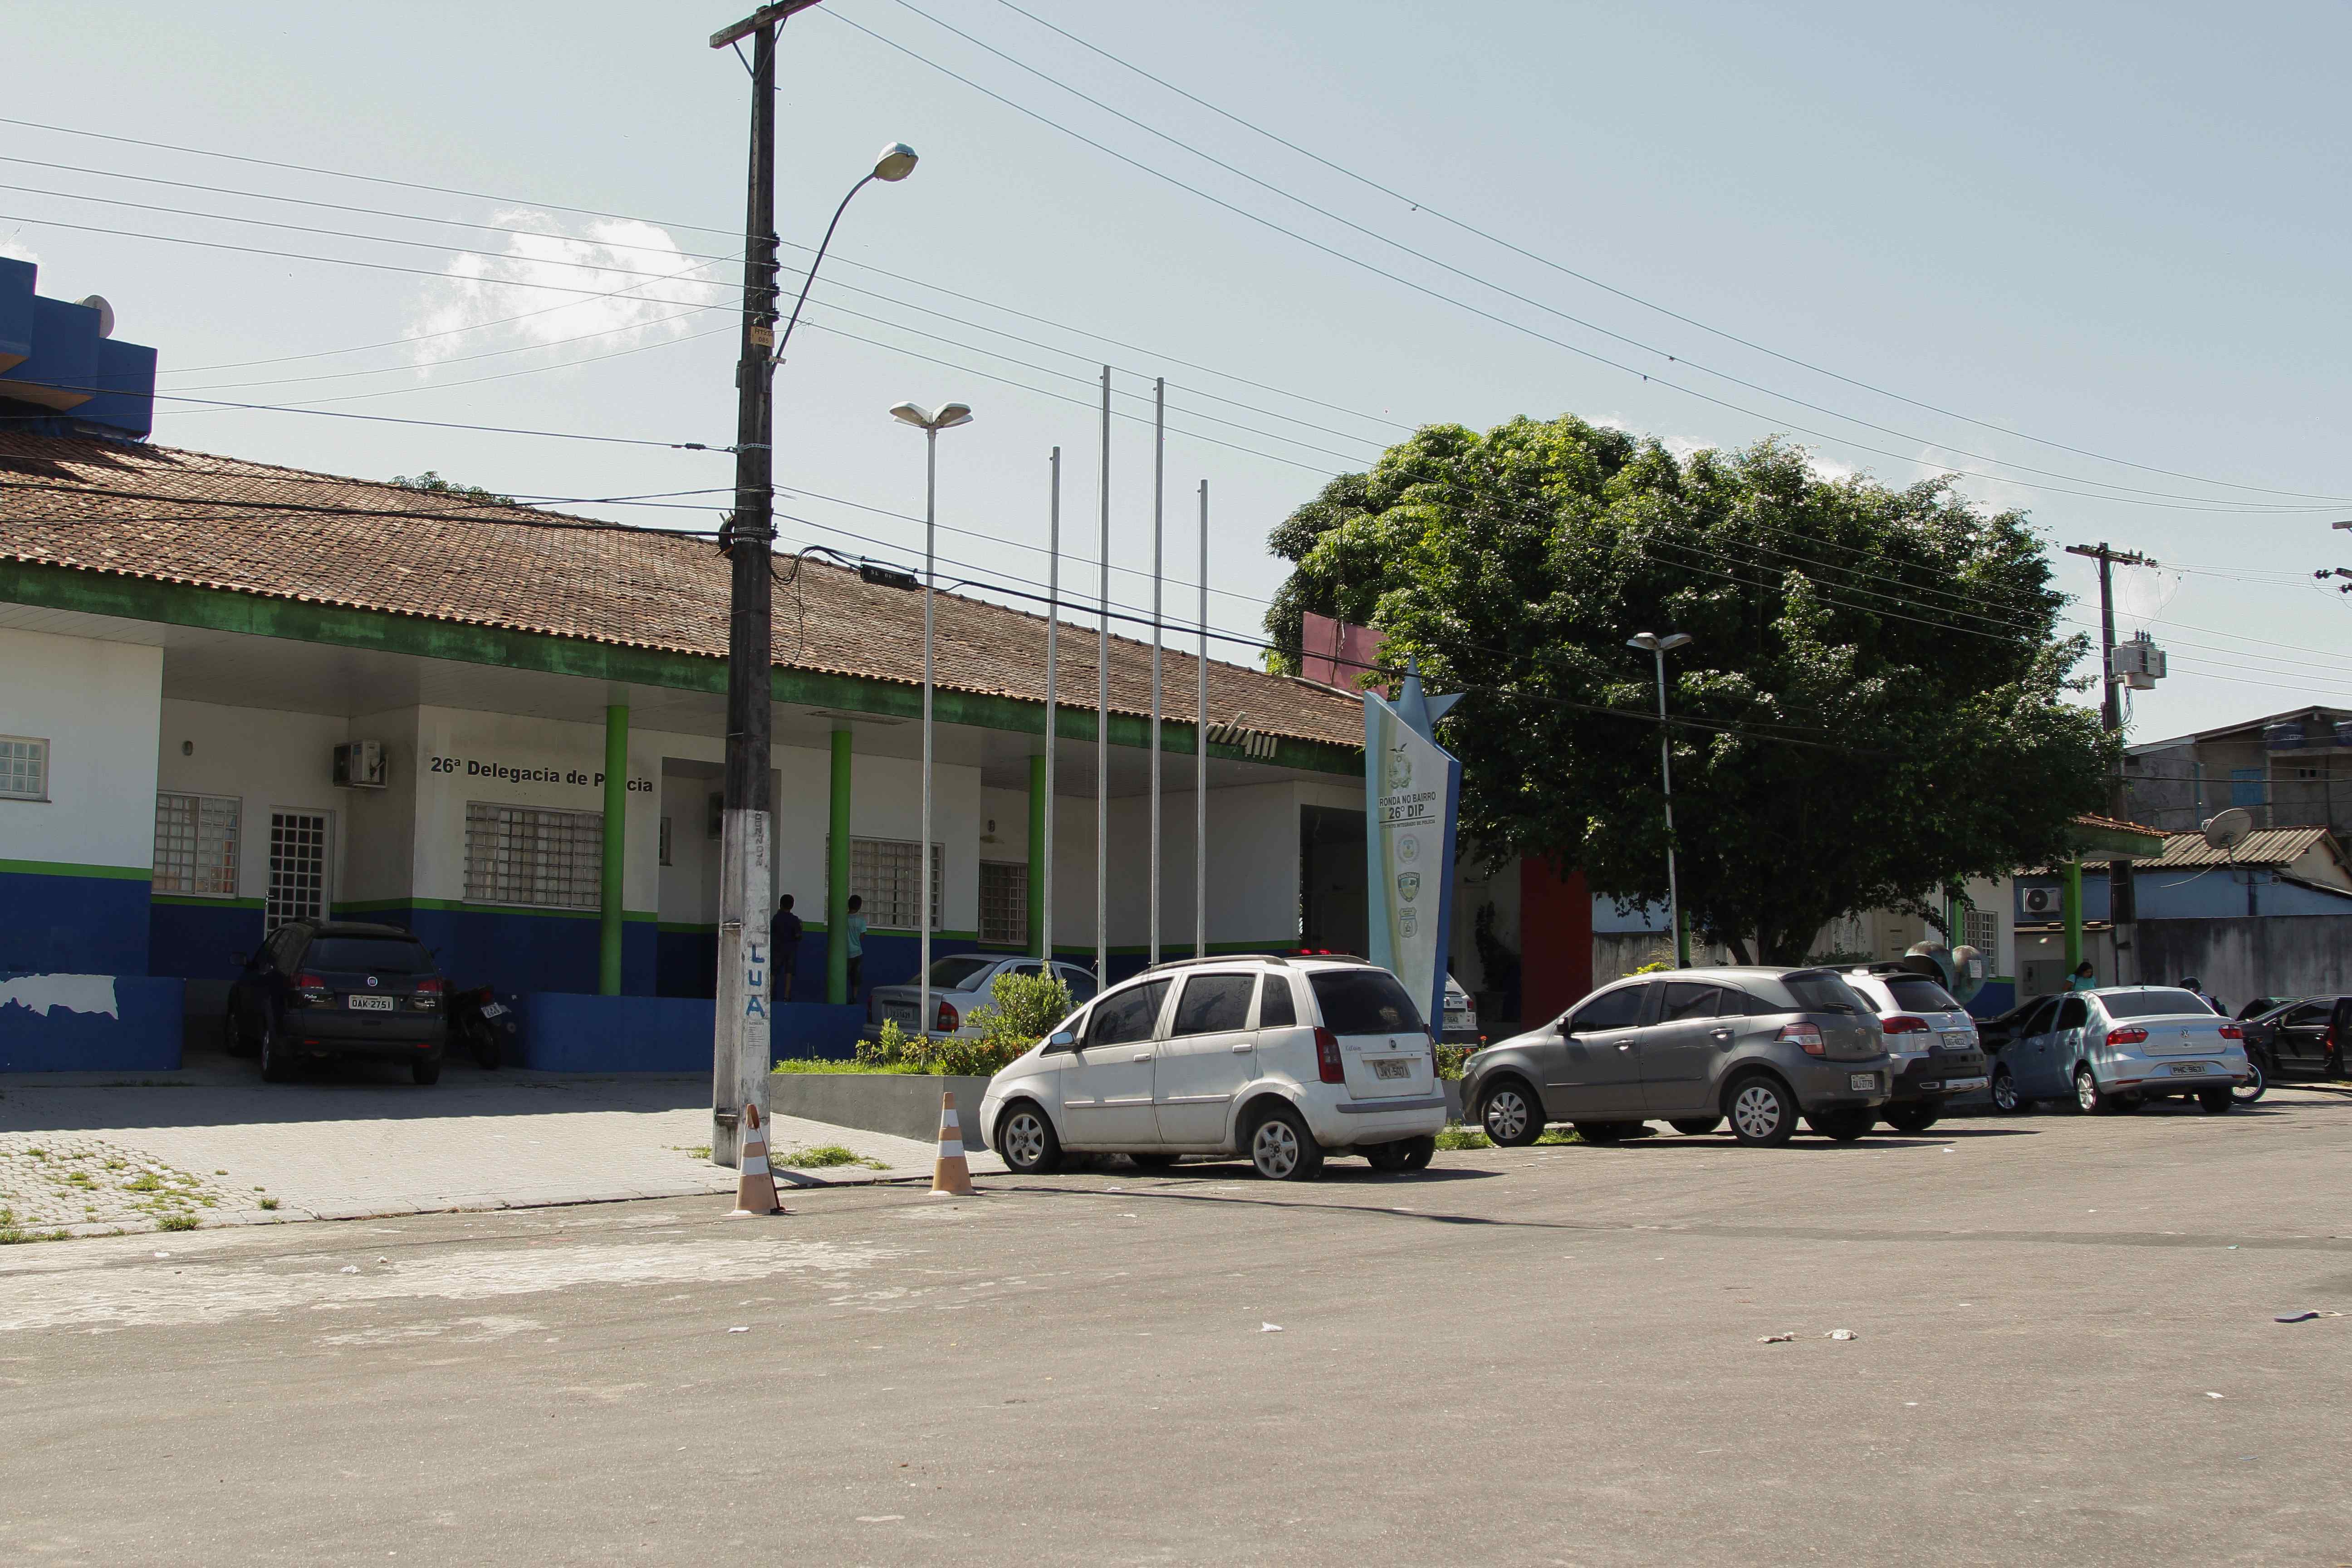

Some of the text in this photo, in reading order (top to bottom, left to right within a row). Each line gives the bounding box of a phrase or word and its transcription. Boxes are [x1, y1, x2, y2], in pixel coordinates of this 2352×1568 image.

[468, 760, 560, 783] Delegacia
[566, 770, 588, 785] de
[1380, 792, 1436, 807] RONDA NO BAIRRO
[1408, 804, 1425, 817] DIP
